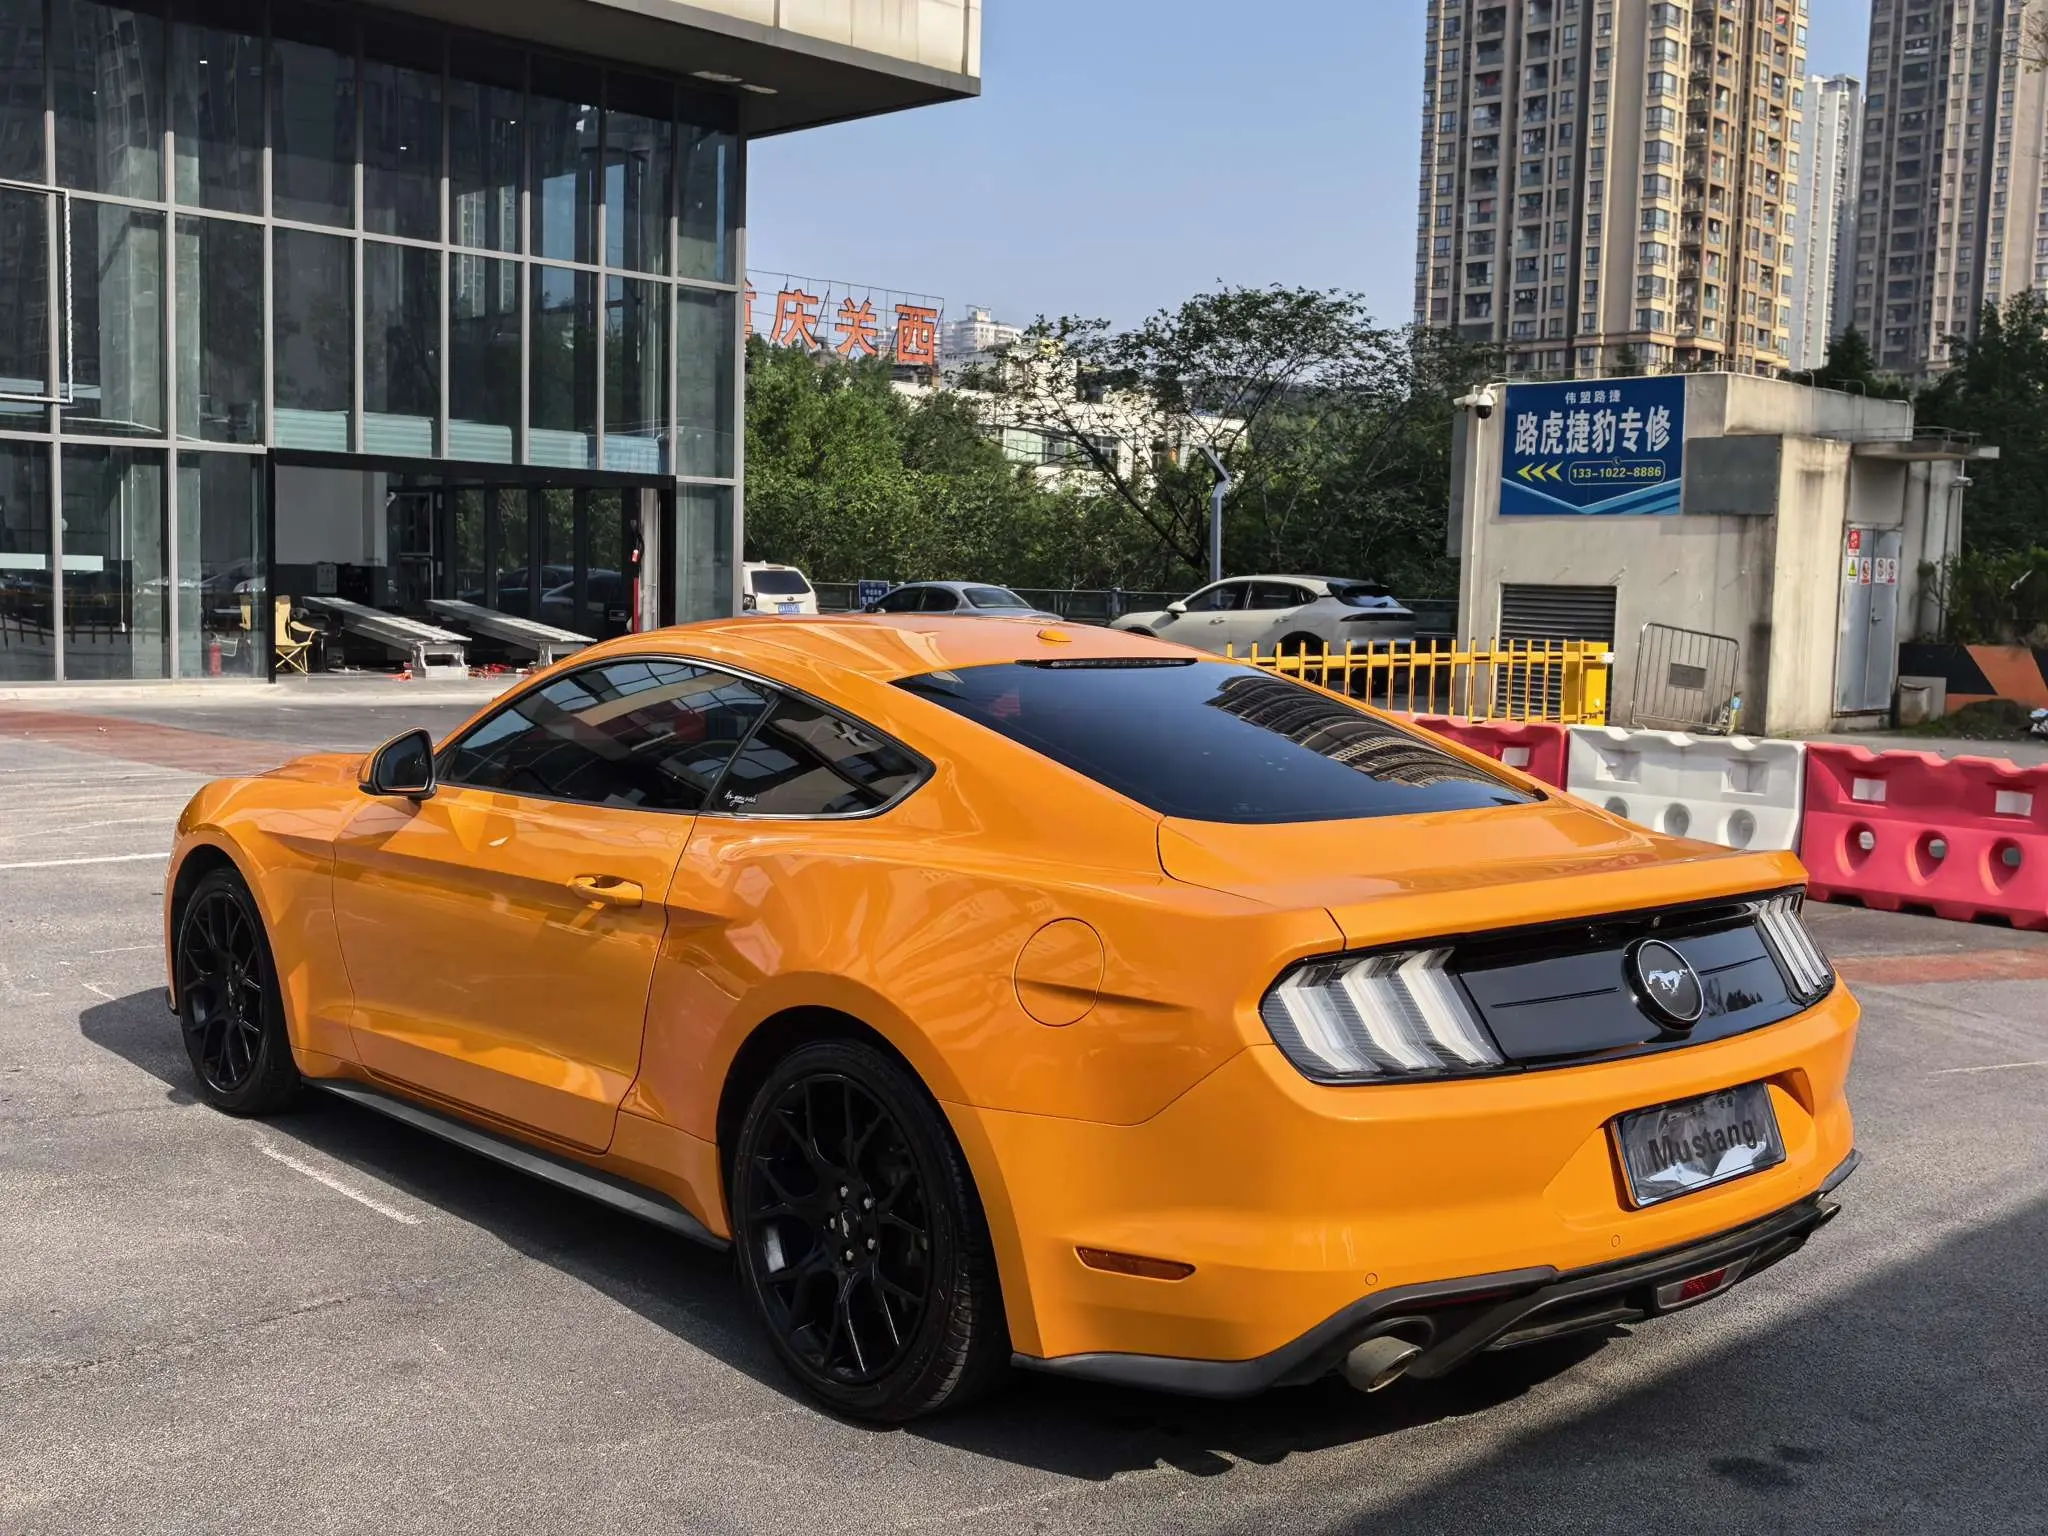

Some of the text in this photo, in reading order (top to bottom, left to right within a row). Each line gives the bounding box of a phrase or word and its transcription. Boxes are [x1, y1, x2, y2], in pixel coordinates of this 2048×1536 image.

[1565, 389, 1621, 405] 伟盟路捷
[1514, 405, 1672, 456] 路虎捷豹专修
[1572, 466, 1662, 478] 133-1022-8886
[1648, 1118, 1758, 1172] Mustang
